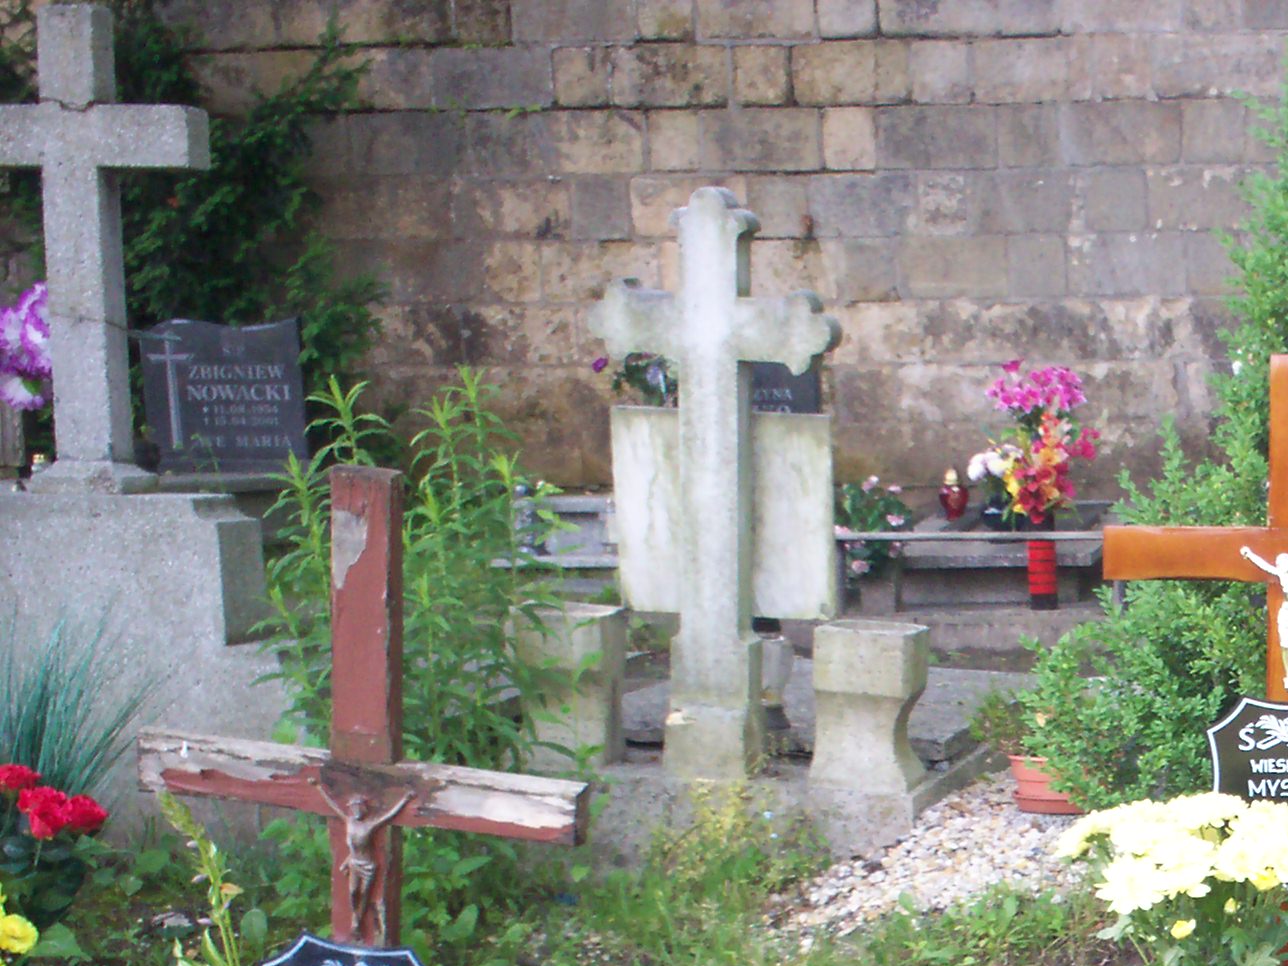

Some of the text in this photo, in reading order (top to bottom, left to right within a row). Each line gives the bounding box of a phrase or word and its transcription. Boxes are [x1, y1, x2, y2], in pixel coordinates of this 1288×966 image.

[188, 365, 286, 379] ZBIGNIEW
[186, 384, 291, 401] NOWACKI
[236, 435, 292, 448] MARIA
